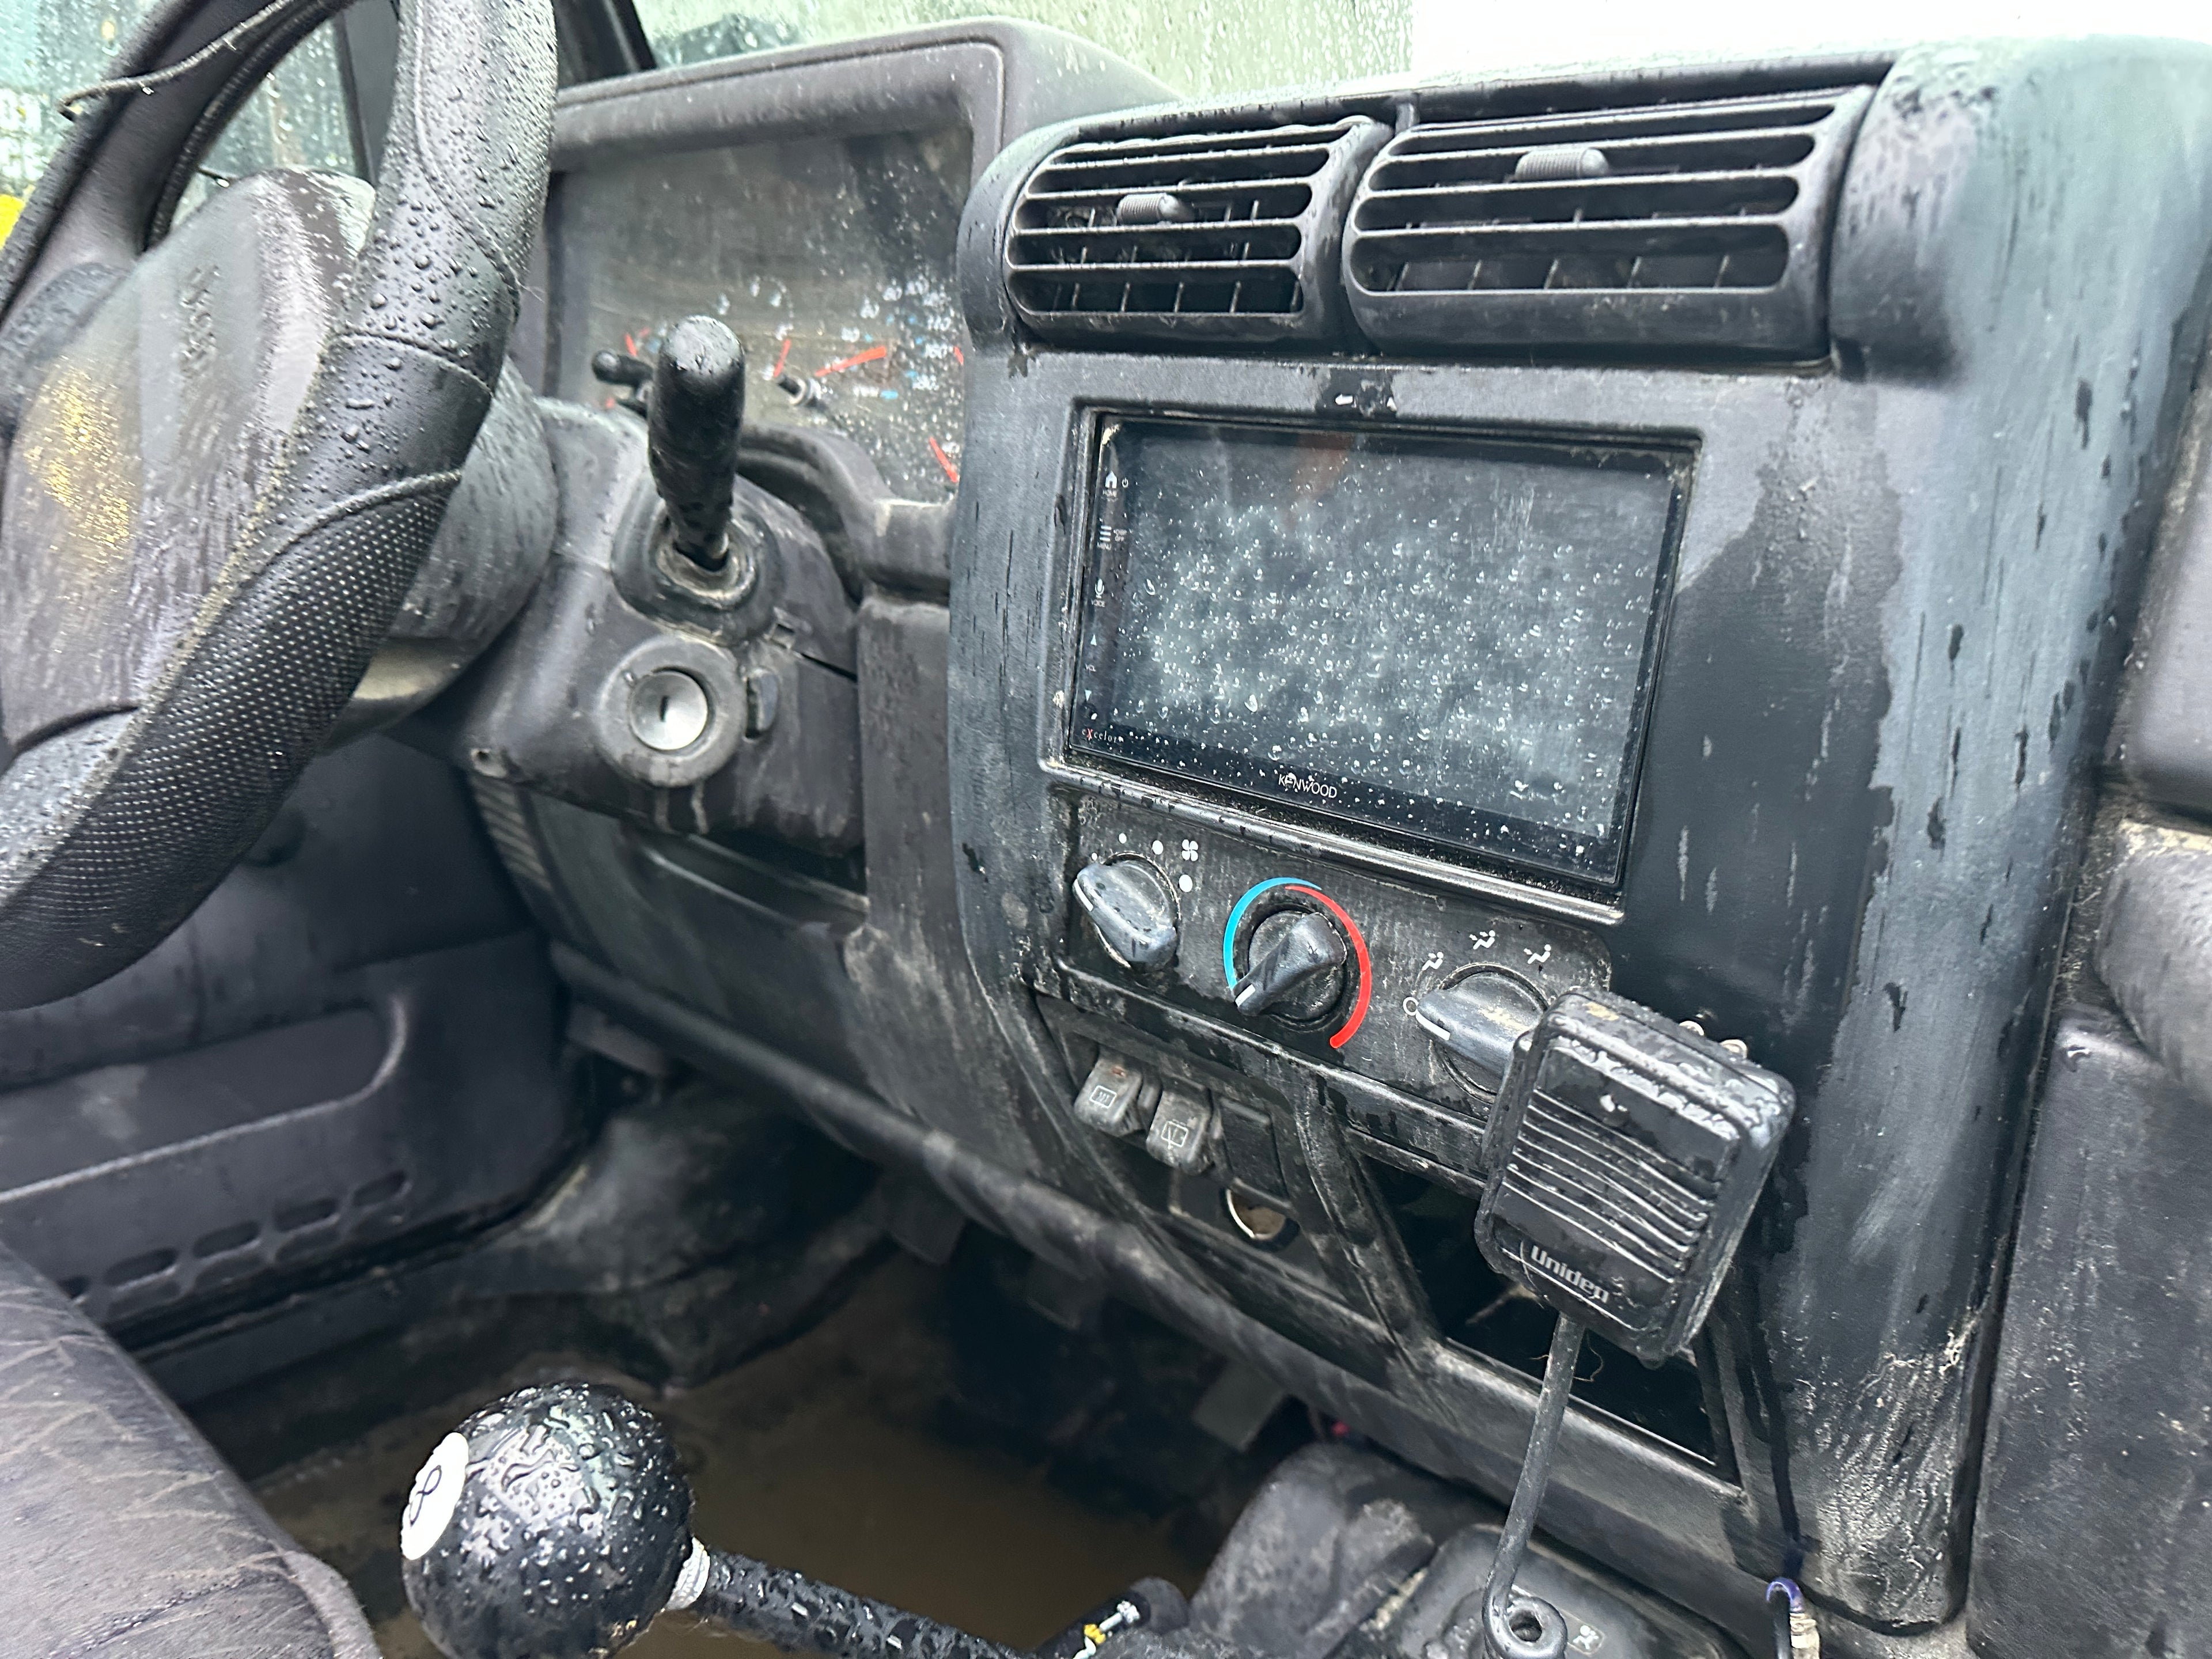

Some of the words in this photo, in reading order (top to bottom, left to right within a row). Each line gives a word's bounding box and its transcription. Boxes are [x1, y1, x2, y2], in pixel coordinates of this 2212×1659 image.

[1278, 774, 1338, 799] KENWOOD
[1530, 1245, 1610, 1304] Uniden
[409, 1464, 442, 1527] 8
